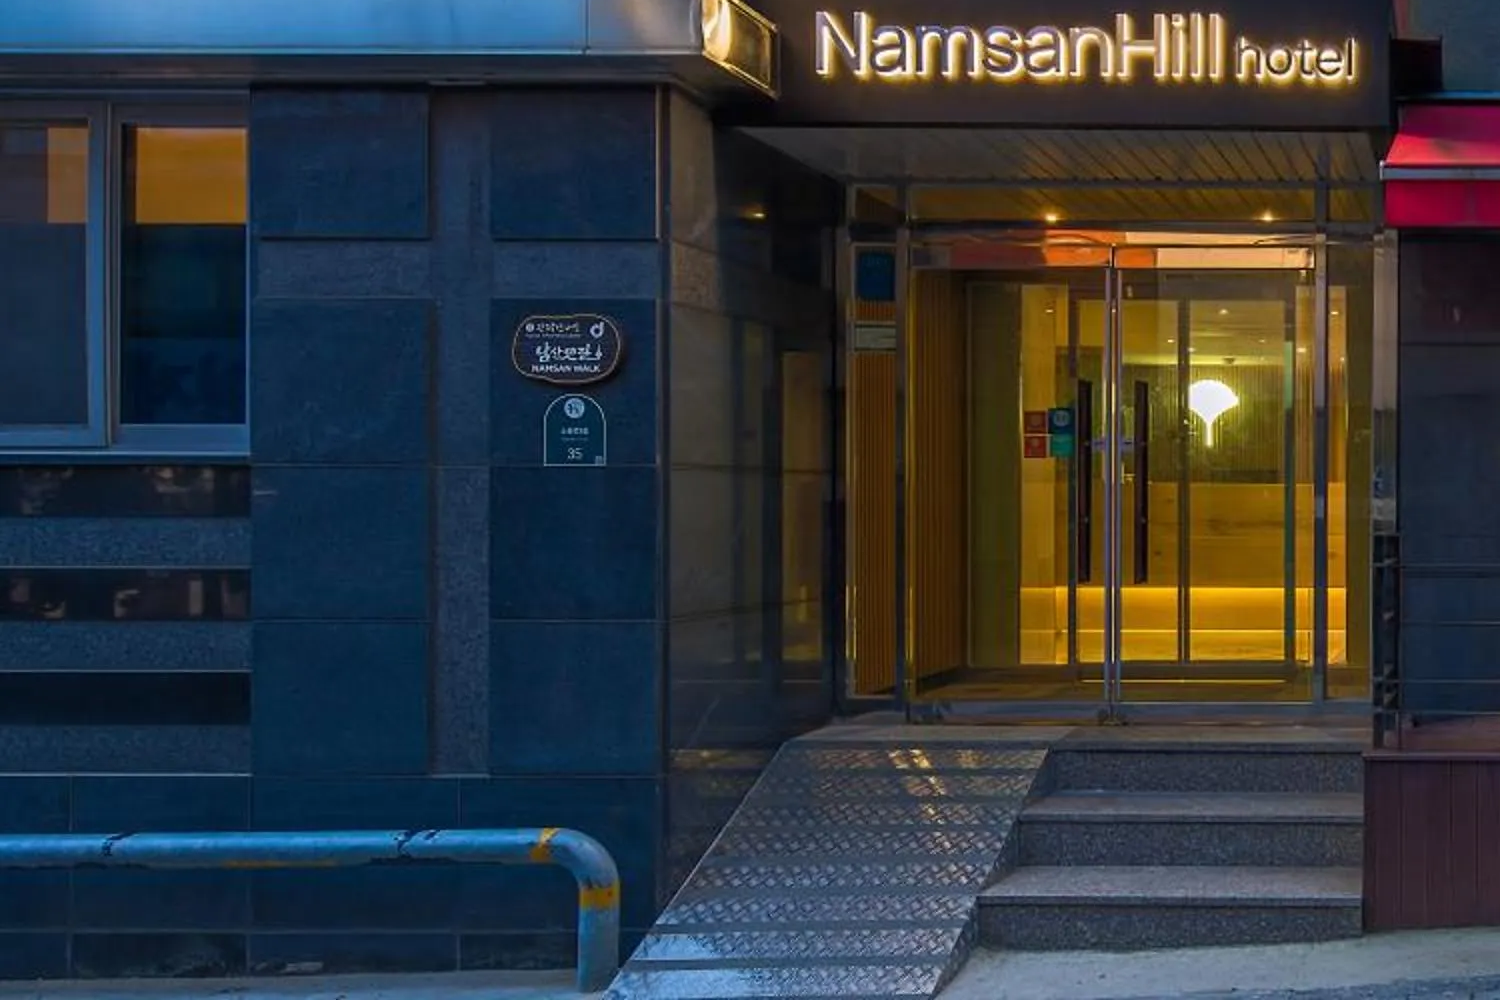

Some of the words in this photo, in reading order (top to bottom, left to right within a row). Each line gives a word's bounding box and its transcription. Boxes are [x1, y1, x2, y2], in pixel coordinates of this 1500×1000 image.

[814, 10, 1225, 80] NamsanHill
[1233, 35, 1358, 81] hotel
[567, 447, 584, 461] 35
